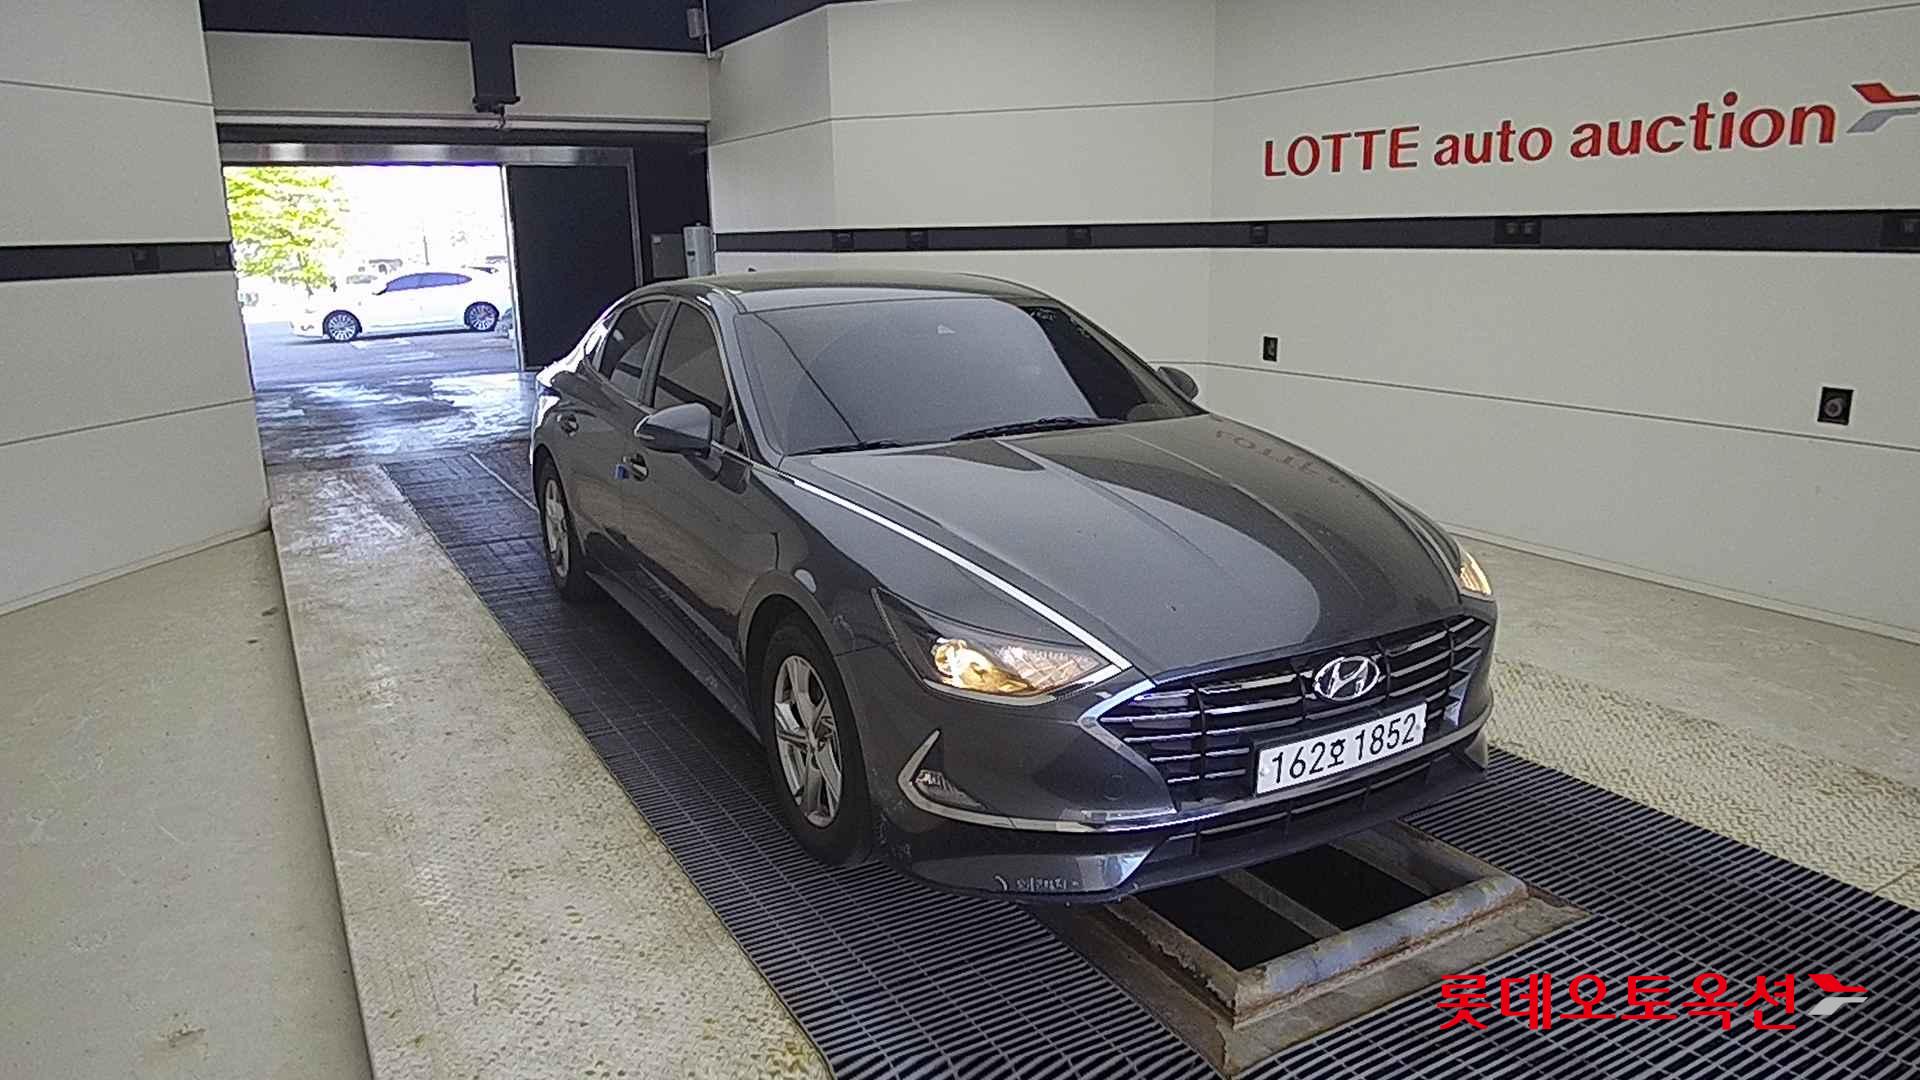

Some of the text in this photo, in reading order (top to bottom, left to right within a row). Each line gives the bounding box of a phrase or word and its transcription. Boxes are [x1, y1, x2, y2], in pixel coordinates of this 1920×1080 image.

[1264, 91, 1836, 177] LOTTE auto auction
[1272, 712, 1417, 784] 162호 1852
